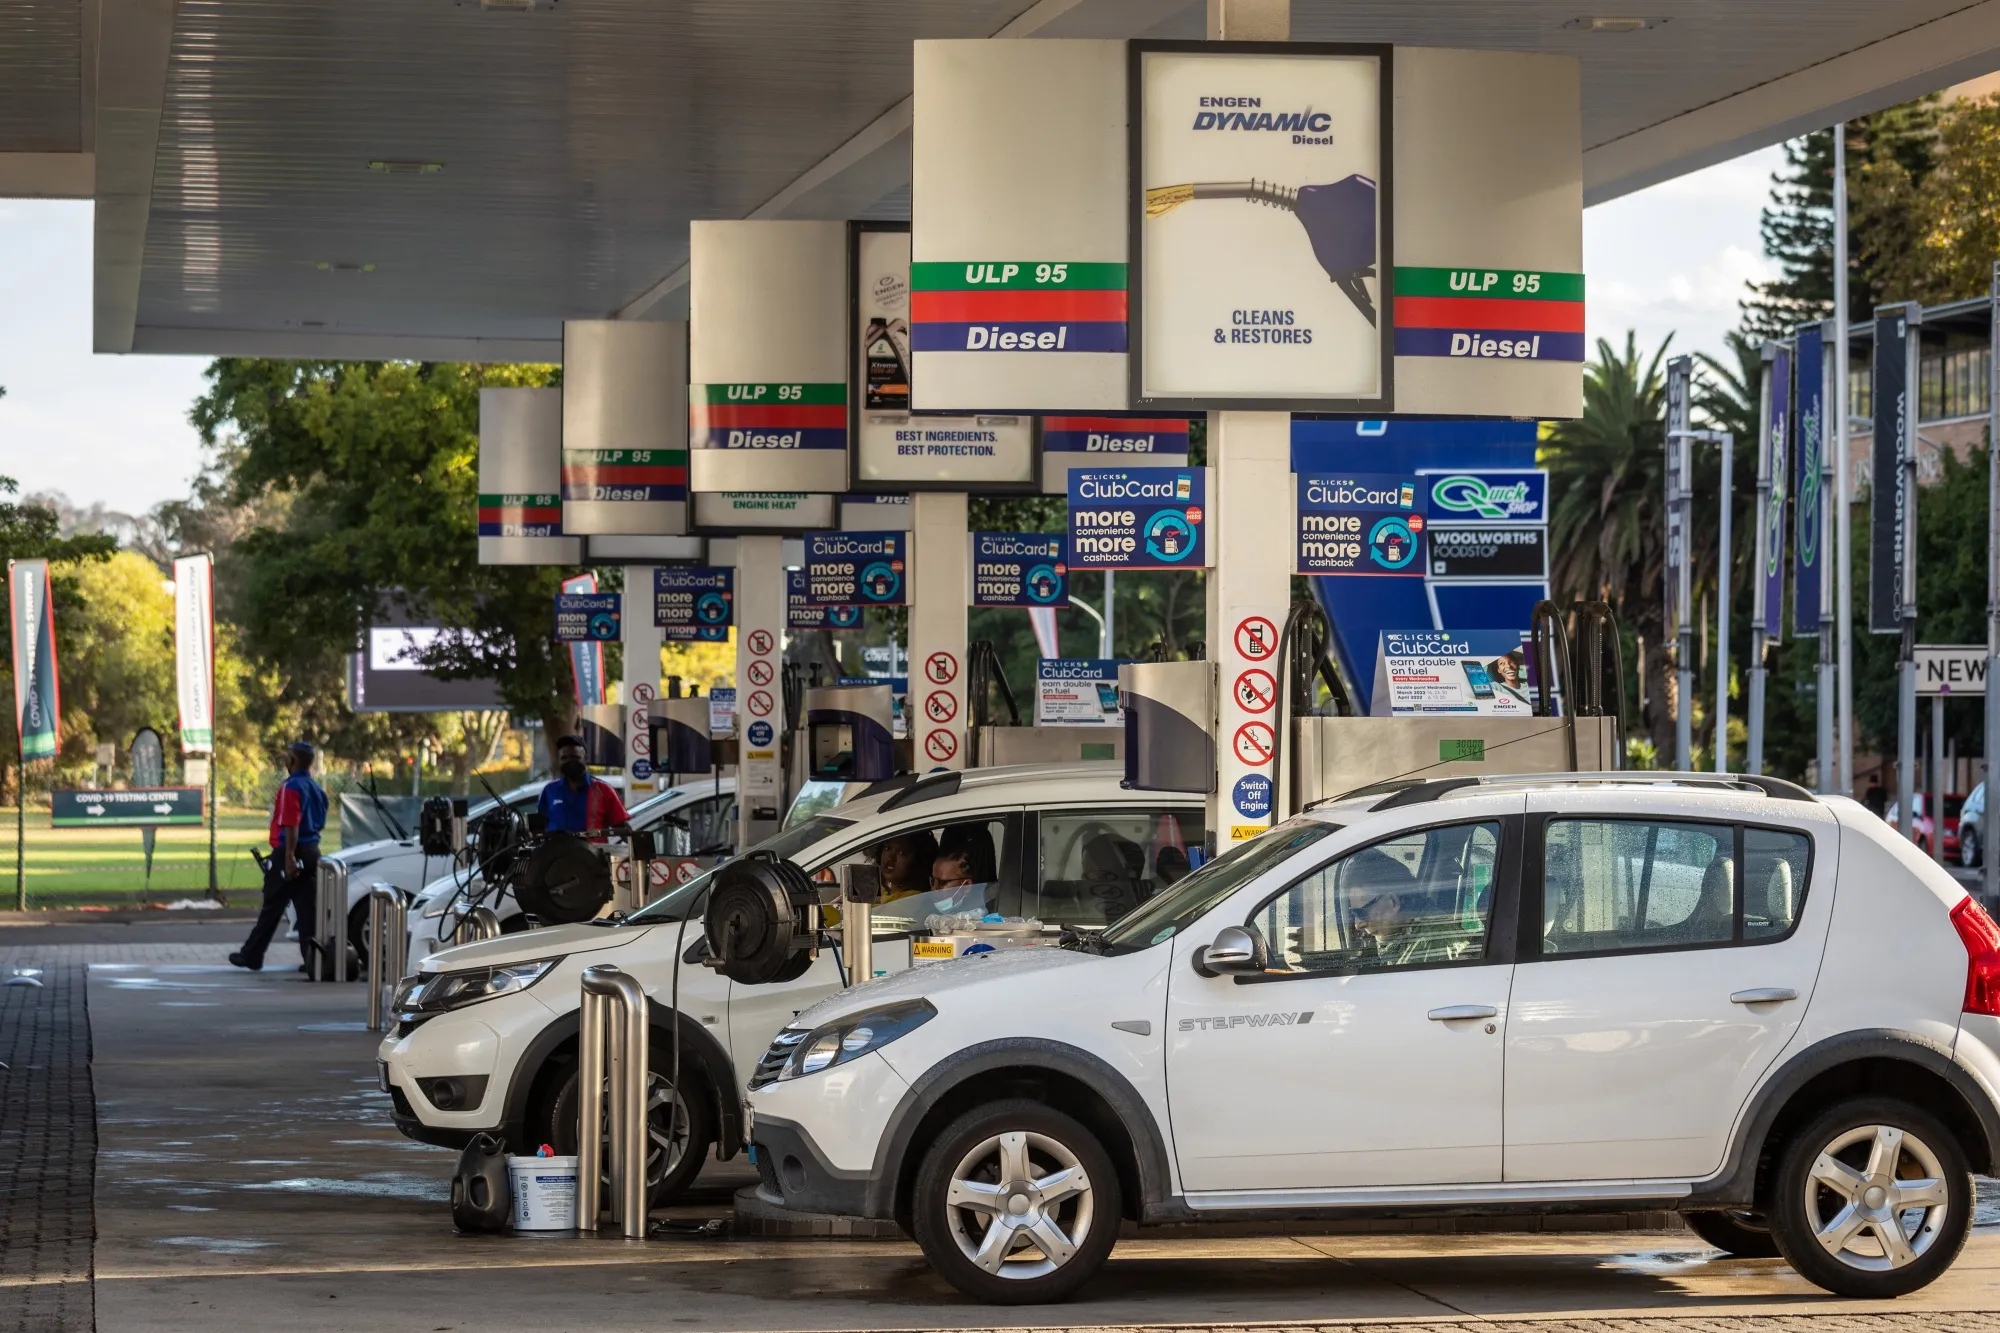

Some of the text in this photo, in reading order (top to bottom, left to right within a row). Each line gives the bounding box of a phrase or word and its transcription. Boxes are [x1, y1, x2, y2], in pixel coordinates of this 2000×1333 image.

[1200, 97, 1261, 107] ENGEN
[1192, 108, 1332, 132] DYNAMIC
[1292, 135, 1333, 145] Diesel
[965, 264, 1067, 284] ULP 95
[1449, 272, 1540, 293] ULP 95
[1232, 310, 1295, 326] CLEANS
[965, 326, 1066, 351] Diesel
[1214, 327, 1312, 344] & RESTORES
[1450, 334, 1540, 358] Diesel
[727, 386, 802, 400] ULP 95
[728, 431, 801, 448] Diesel
[896, 431, 998, 442] BEST INGREDIENTS.
[1086, 434, 1155, 452] Diesel
[592, 450, 651, 462] ULP 95
[897, 445, 996, 456] BEST PROTECTION.
[593, 487, 650, 501] Diesel
[1079, 481, 1174, 498] ClubCard
[502, 495, 551, 505] ULP 95
[1307, 487, 1398, 505] ClubCard
[733, 501, 797, 509] ENGINE HEAT
[1507, 501, 1538, 514] SHOP
[1076, 511, 1135, 527] more
[1302, 516, 1361, 532] more
[502, 525, 551, 537] Diesel
[1076, 527, 1136, 536] convenience
[1302, 533, 1361, 541] convenience
[1434, 532, 1538, 544] WOOLWORTHS
[813, 541, 882, 555] ClubCard
[981, 542, 1047, 556] ClubCard
[1076, 537, 1136, 553] more
[1302, 542, 1361, 558] more
[1083, 553, 1129, 562] cashback
[1434, 546, 1498, 558] FOODSTOP
[1308, 559, 1354, 567] cashback
[810, 563, 855, 576] more
[978, 564, 1021, 576] more
[660, 576, 715, 587] ClubCard
[811, 582, 855, 595] more
[978, 583, 1021, 595] more
[657, 593, 693, 603] more
[816, 594, 851, 602] cashback
[560, 600, 606, 609] ClubCard
[558, 613, 588, 622] more
[658, 608, 693, 618] more
[789, 610, 824, 620] more
[558, 626, 588, 635] more
[668, 626, 697, 635] more
[1389, 642, 1470, 655] ClubCard
[1390, 658, 1456, 667] earn double
[1042, 668, 1103, 678] ClubCard
[1408, 666, 1428, 675] fuel
[1928, 659, 1987, 682] NEW
[1063, 680, 1092, 688] double
[1241, 781, 1268, 790] Switch
[76, 793, 115, 803] COVID-19
[116, 792, 148, 803] TESTING
[1248, 791, 1261, 800] Off
[1240, 801, 1268, 811] Engine
[921, 946, 952, 954] WARNING
[1178, 1012, 1298, 1032] STEPWAY
